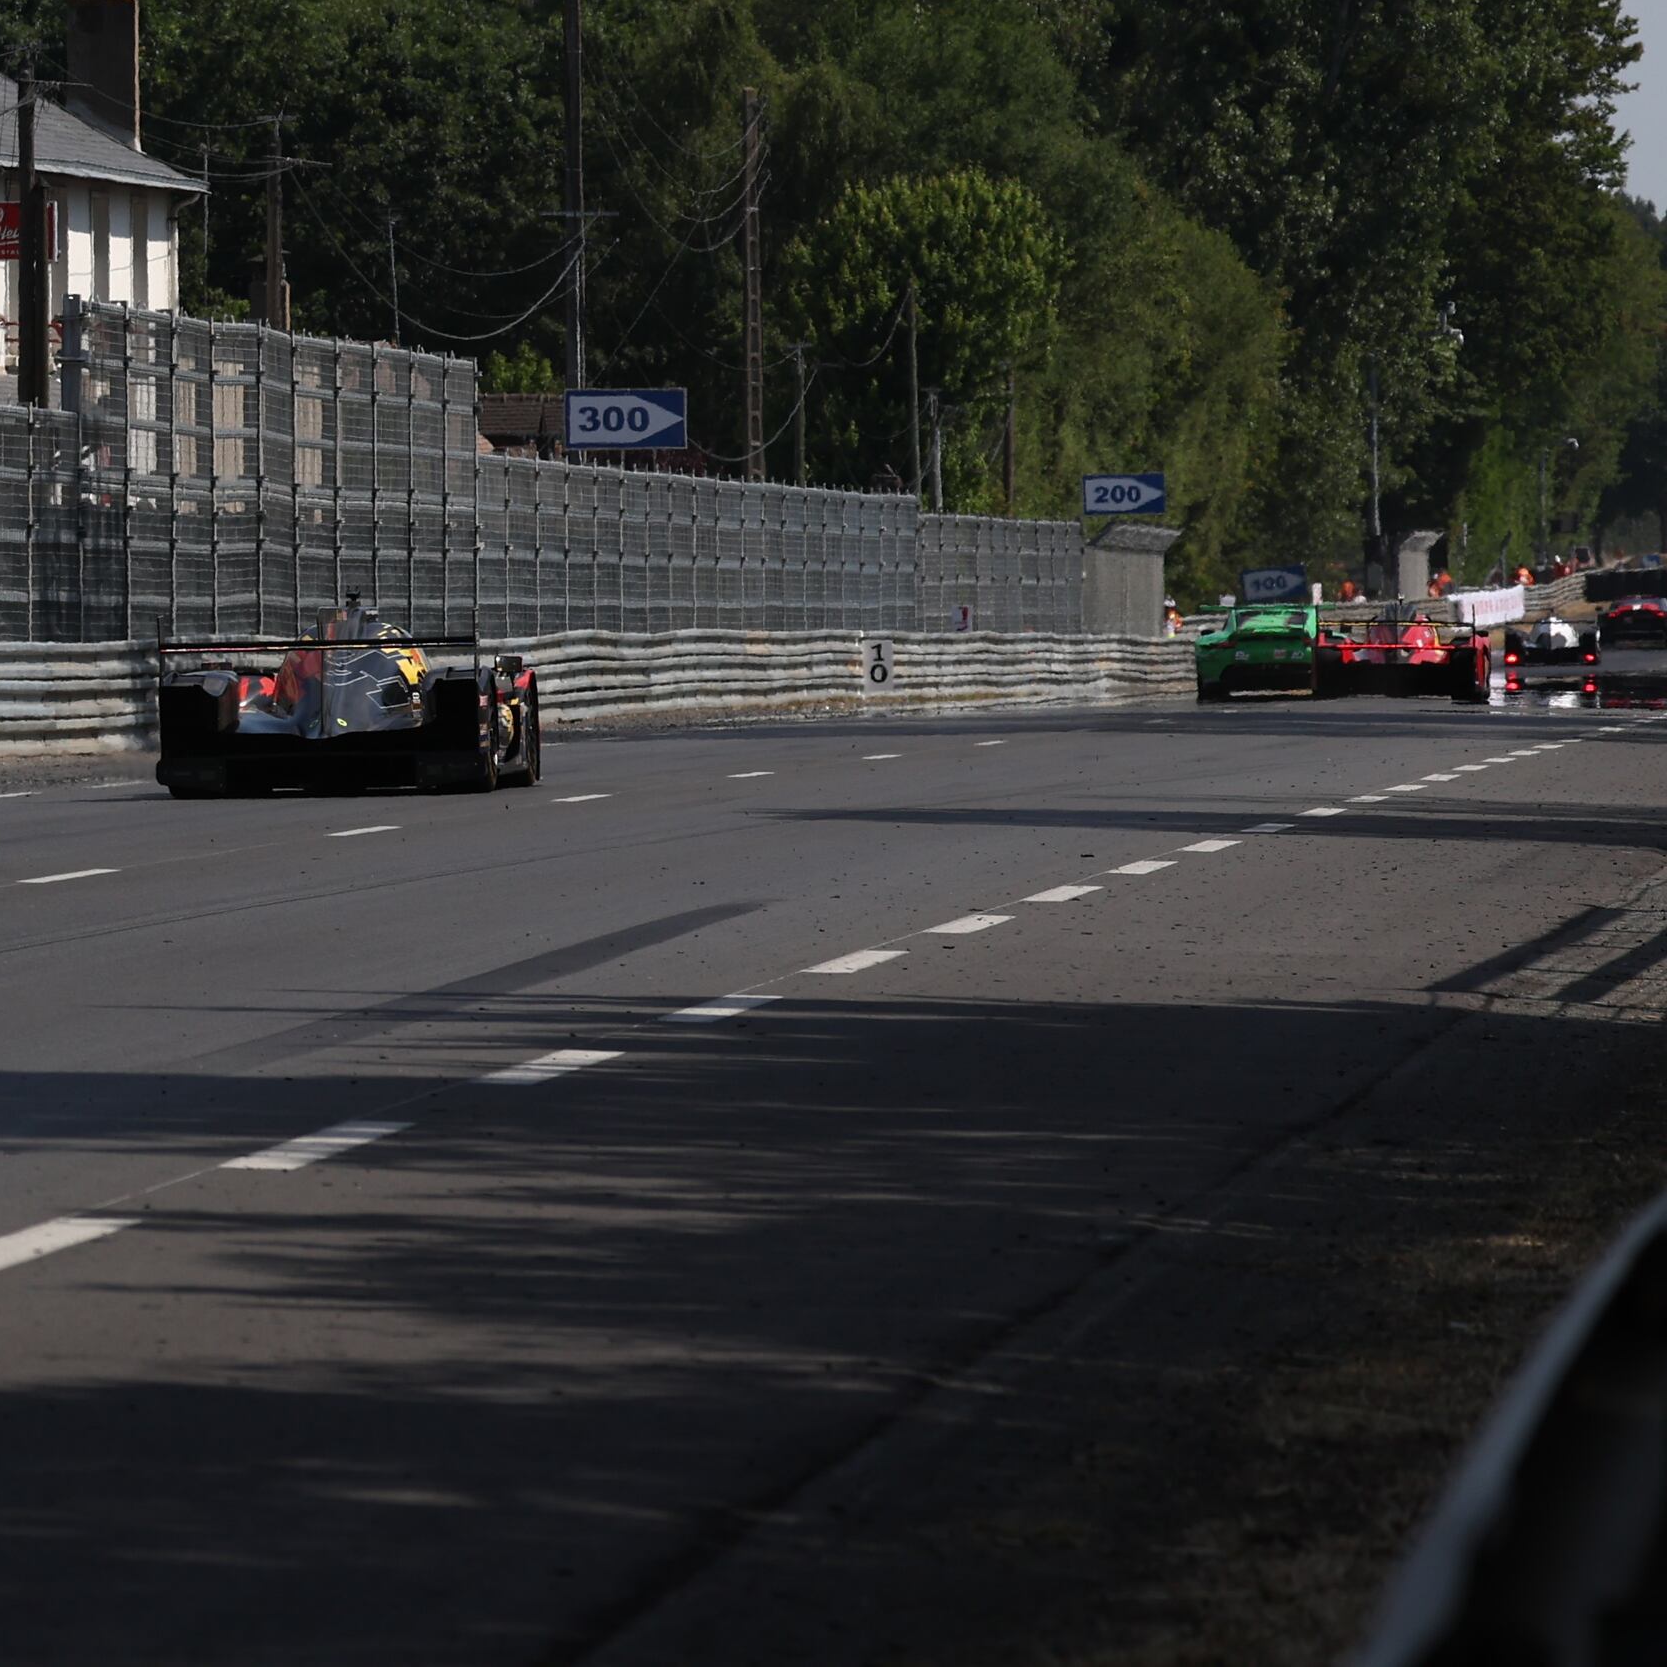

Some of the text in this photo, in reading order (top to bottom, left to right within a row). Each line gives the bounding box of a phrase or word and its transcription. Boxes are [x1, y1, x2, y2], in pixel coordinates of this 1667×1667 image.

[578, 405, 650, 432] 300
[1094, 485, 1141, 503] 200
[1251, 576, 1286, 591] 100
